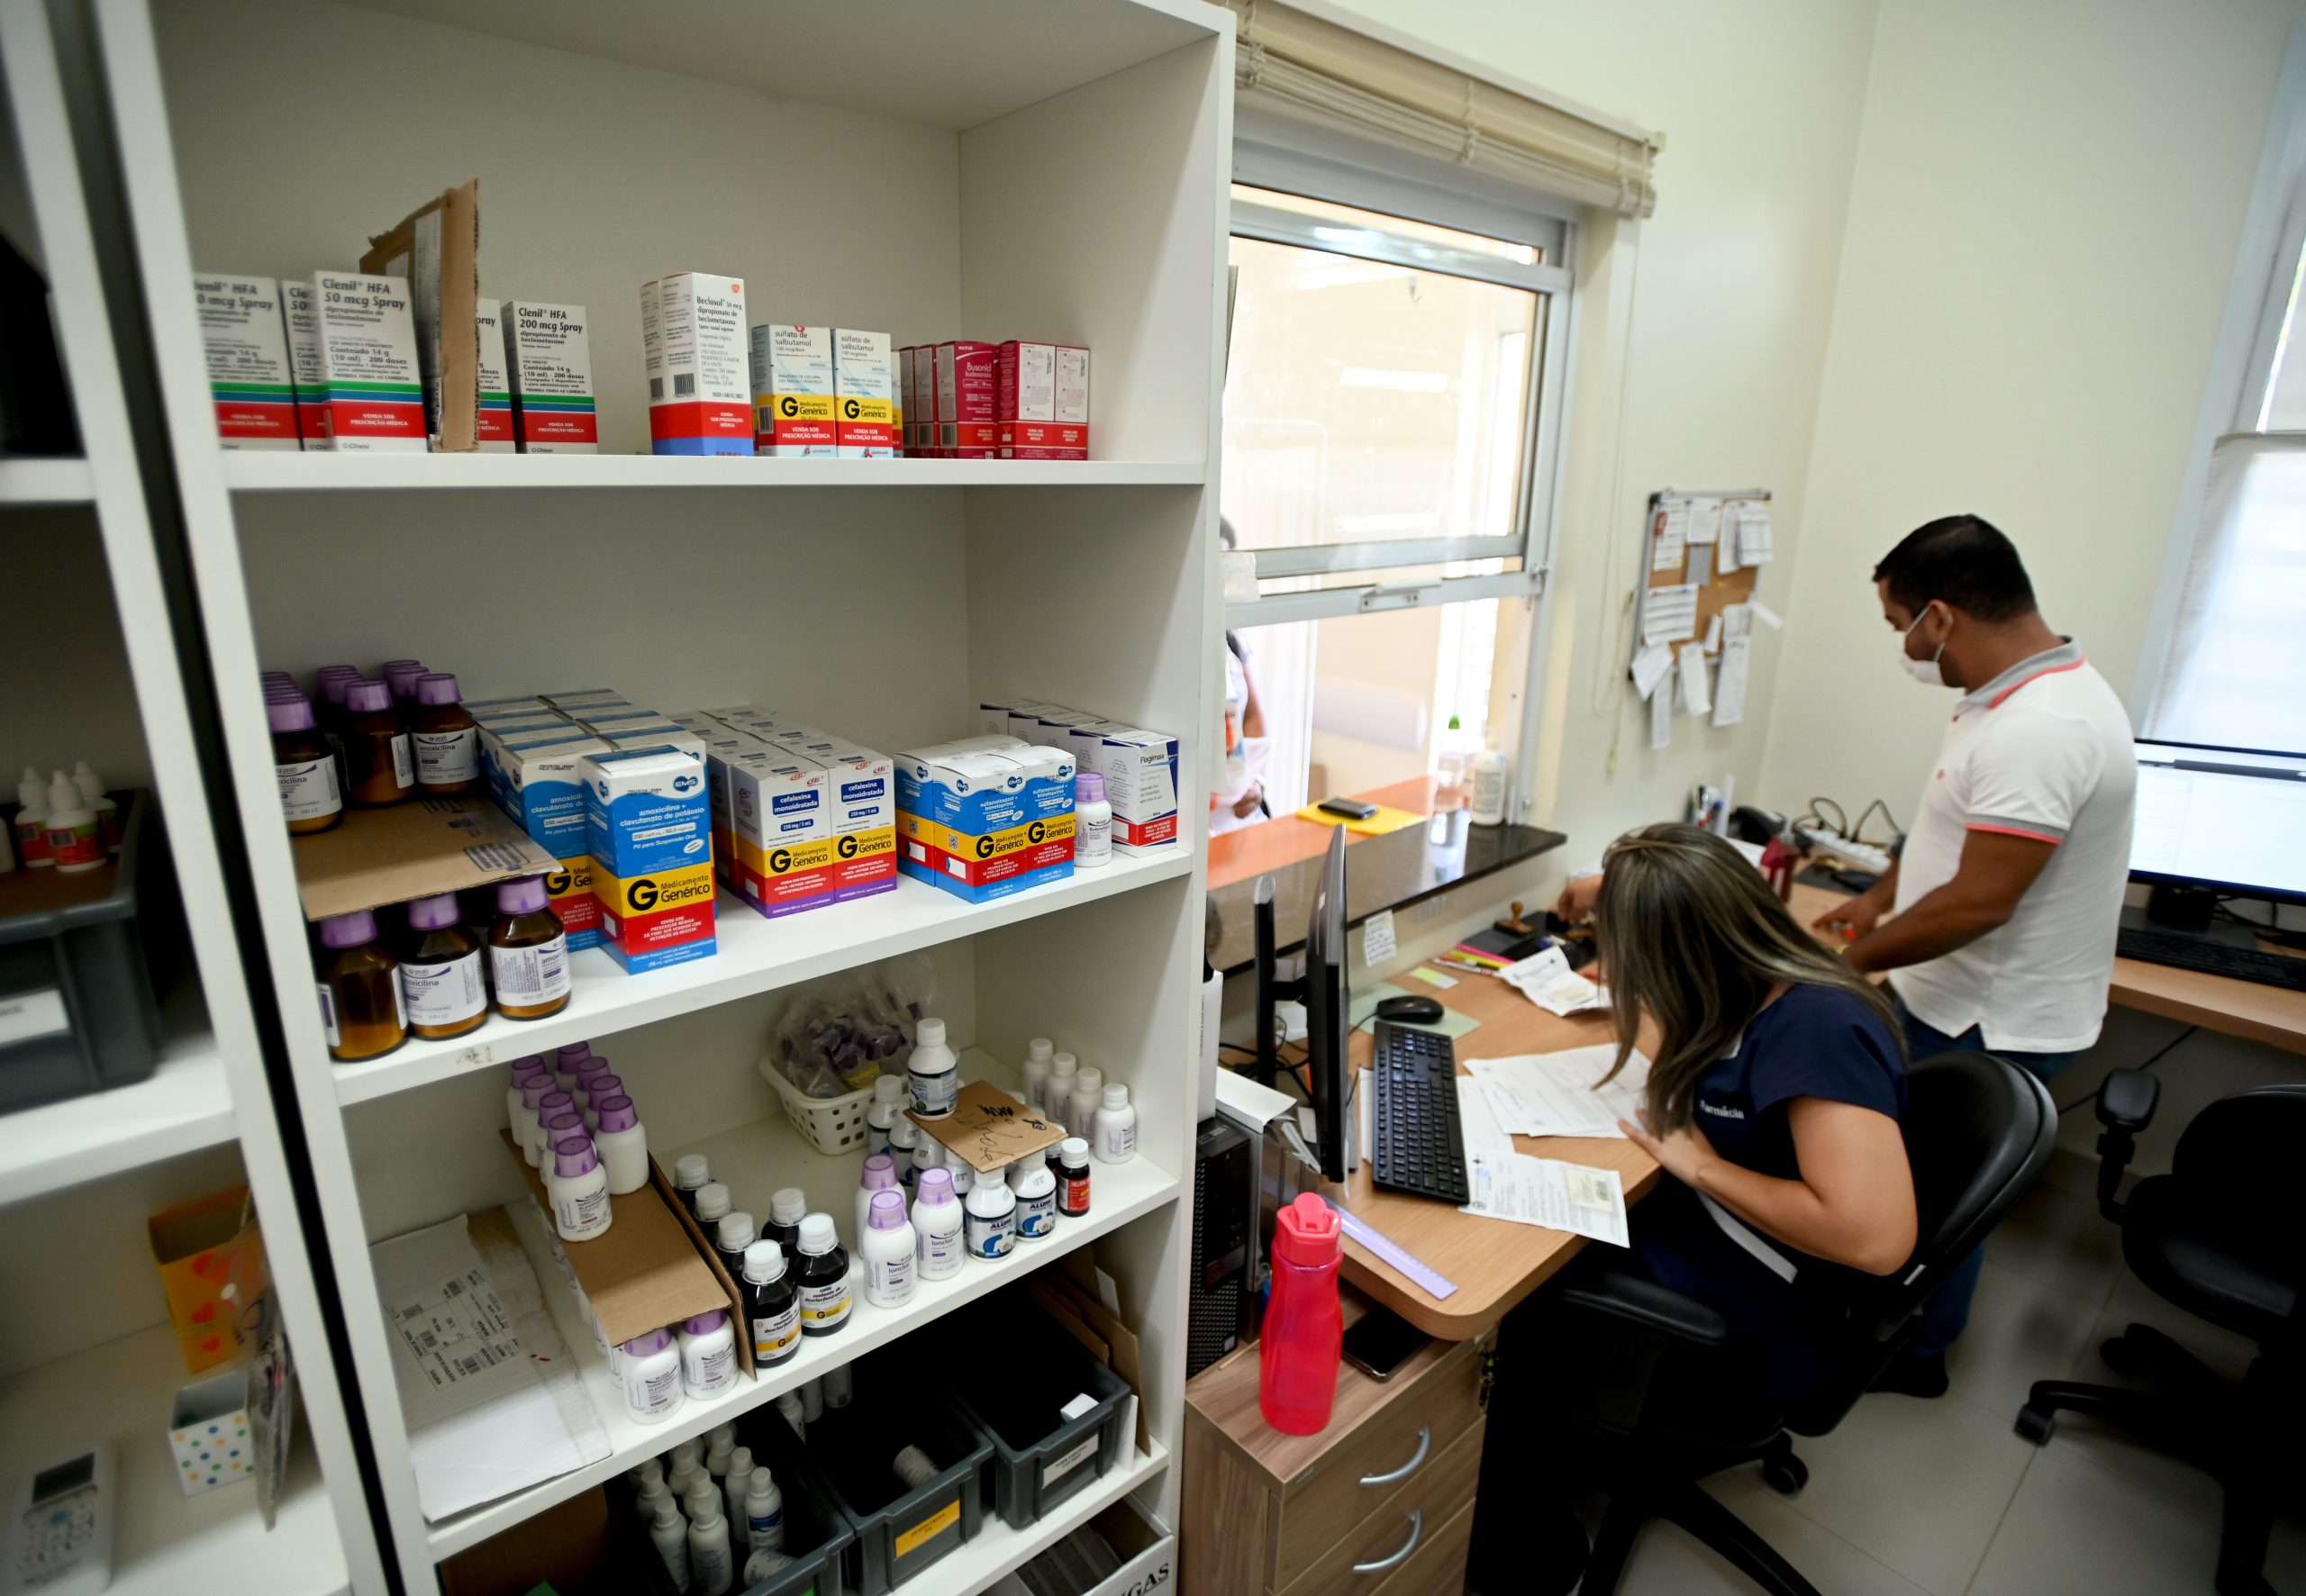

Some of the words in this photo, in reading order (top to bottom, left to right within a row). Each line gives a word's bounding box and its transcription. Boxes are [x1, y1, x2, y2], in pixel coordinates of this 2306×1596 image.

[193, 279, 223, 293] lenil
[367, 282, 391, 295] HFA
[324, 292, 341, 303] 50
[344, 295, 369, 308] mcg
[372, 294, 405, 311] Spray
[549, 310, 567, 320] HFA
[520, 319, 538, 329] 200
[539, 322, 558, 332] mcg
[559, 321, 583, 333] Spray
[775, 330, 798, 338] sulfato
[799, 331, 808, 339] de
[841, 335, 862, 343] sulfato
[862, 336, 871, 344] de
[775, 338, 812, 347] salbutamol
[841, 343, 874, 351] salbutamol
[523, 364, 555, 372] Conteúdo
[967, 361, 992, 372] Busonid
[781, 396, 799, 417] G
[799, 406, 828, 416] Genérico
[844, 399, 860, 420] G
[860, 409, 887, 419] Genérico
[1139, 753, 1165, 765] Flagimax
[1058, 766, 1072, 775] EMS
[278, 776, 307, 784] xicilina
[675, 778, 696, 787] EMS
[848, 781, 877, 792] cefalexina
[1033, 784, 1065, 794] sulfametoxazol
[779, 793, 812, 803] cefalexina
[842, 788, 884, 801] monoidratada
[1037, 789, 1065, 799] trimetoprima
[774, 800, 818, 813] monoidratada
[980, 796, 1014, 808] sulfametoxazol
[985, 801, 1014, 812] trimetoprima
[531, 803, 573, 814] clavulanato
[639, 804, 680, 817] amoxicilina
[620, 814, 663, 827] clavulanato
[663, 812, 674, 820] de
[675, 807, 705, 818] potássio
[1046, 820, 1073, 830] Medicamento
[995, 832, 1024, 845] Medicamento
[1028, 821, 1046, 844] G
[1046, 827, 1073, 839] Genérico
[858, 834, 892, 845] Medicamento
[793, 847, 828, 857] Medicamento
[838, 835, 858, 859] G
[858, 839, 892, 854] Genérico
[976, 835, 994, 858] G
[995, 839, 1024, 853] Genérico
[769, 848, 792, 874] G
[793, 854, 829, 867] Genérico
[660, 874, 709, 890] Medicamento
[627, 879, 658, 911] G
[660, 882, 711, 903] Genérico
[816, 1310, 826, 1319] G
[777, 1338, 786, 1347] G
[1121, 1563, 1169, 1596] GAS
